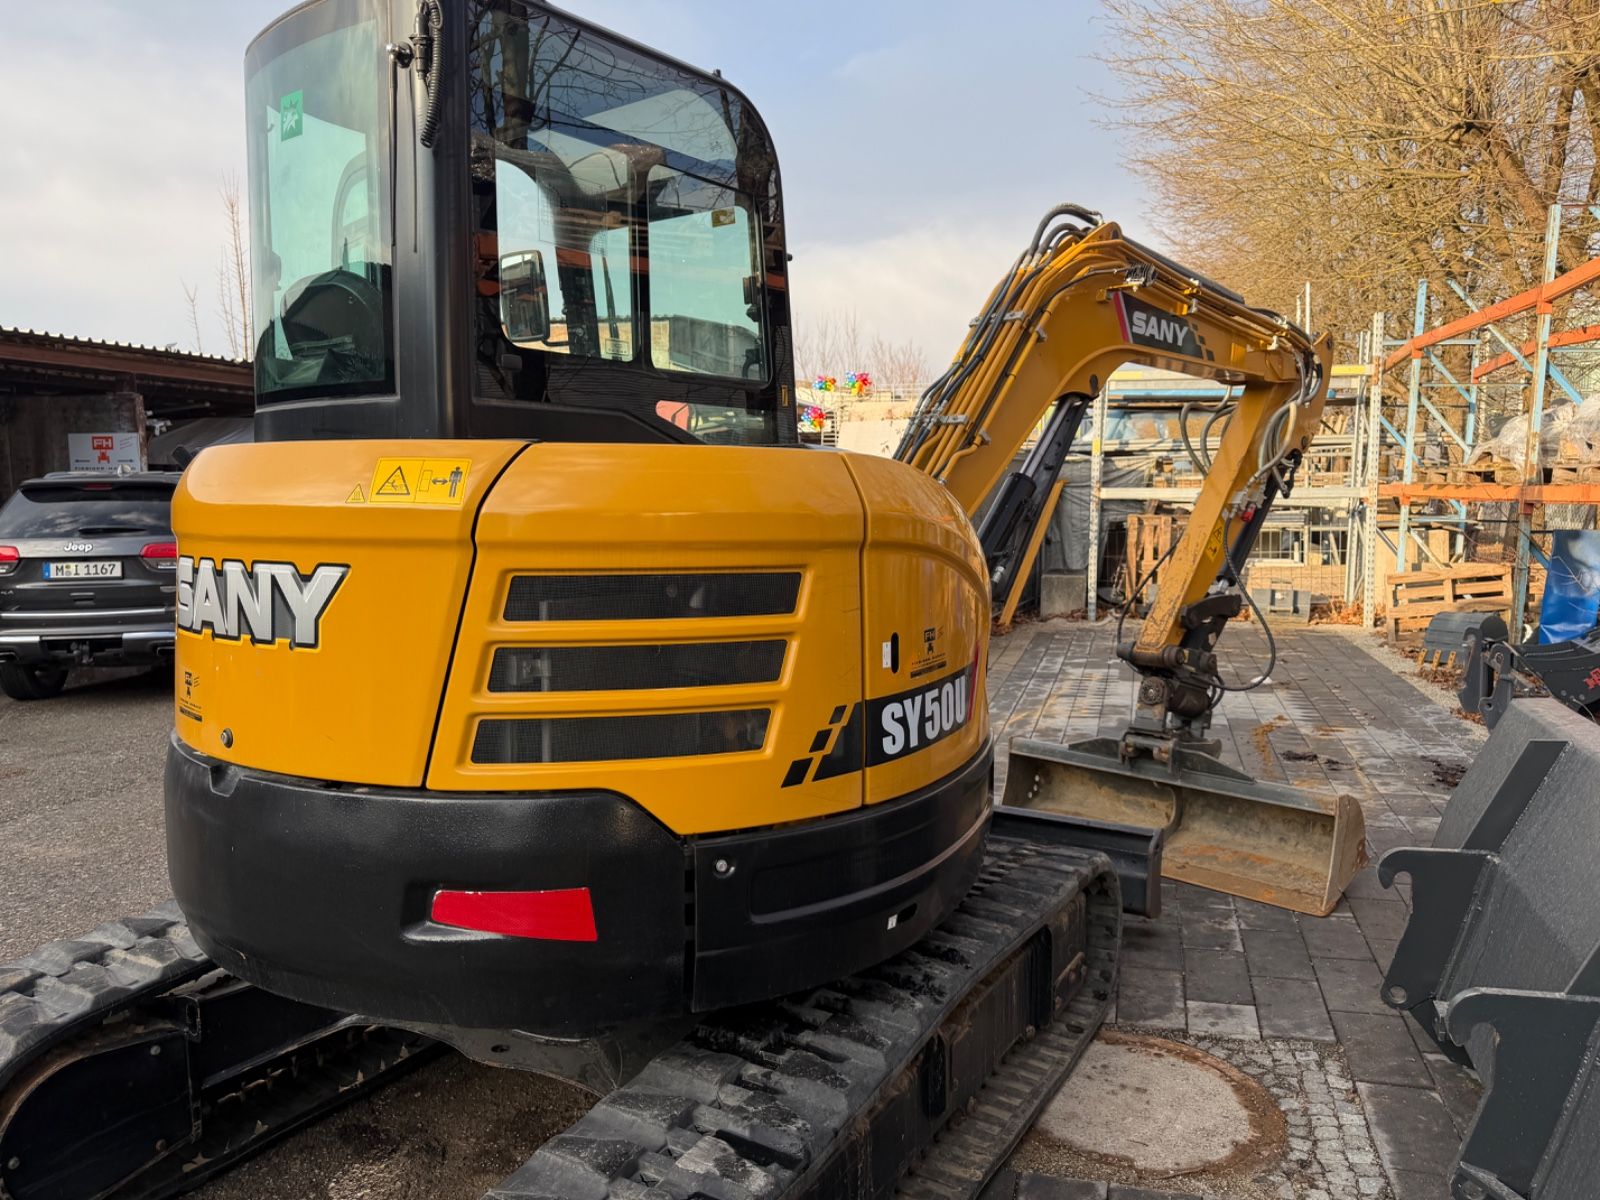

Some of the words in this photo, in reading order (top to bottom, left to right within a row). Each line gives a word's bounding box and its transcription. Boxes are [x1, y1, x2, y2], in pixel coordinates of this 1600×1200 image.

[1132, 311, 1188, 346] SANY
[94, 438, 112, 448] FH
[64, 542, 94, 553] Jeep
[55, 565, 65, 576] M
[73, 565, 80, 576] I
[84, 563, 116, 576] 1167
[882, 675, 966, 755] SY50U
